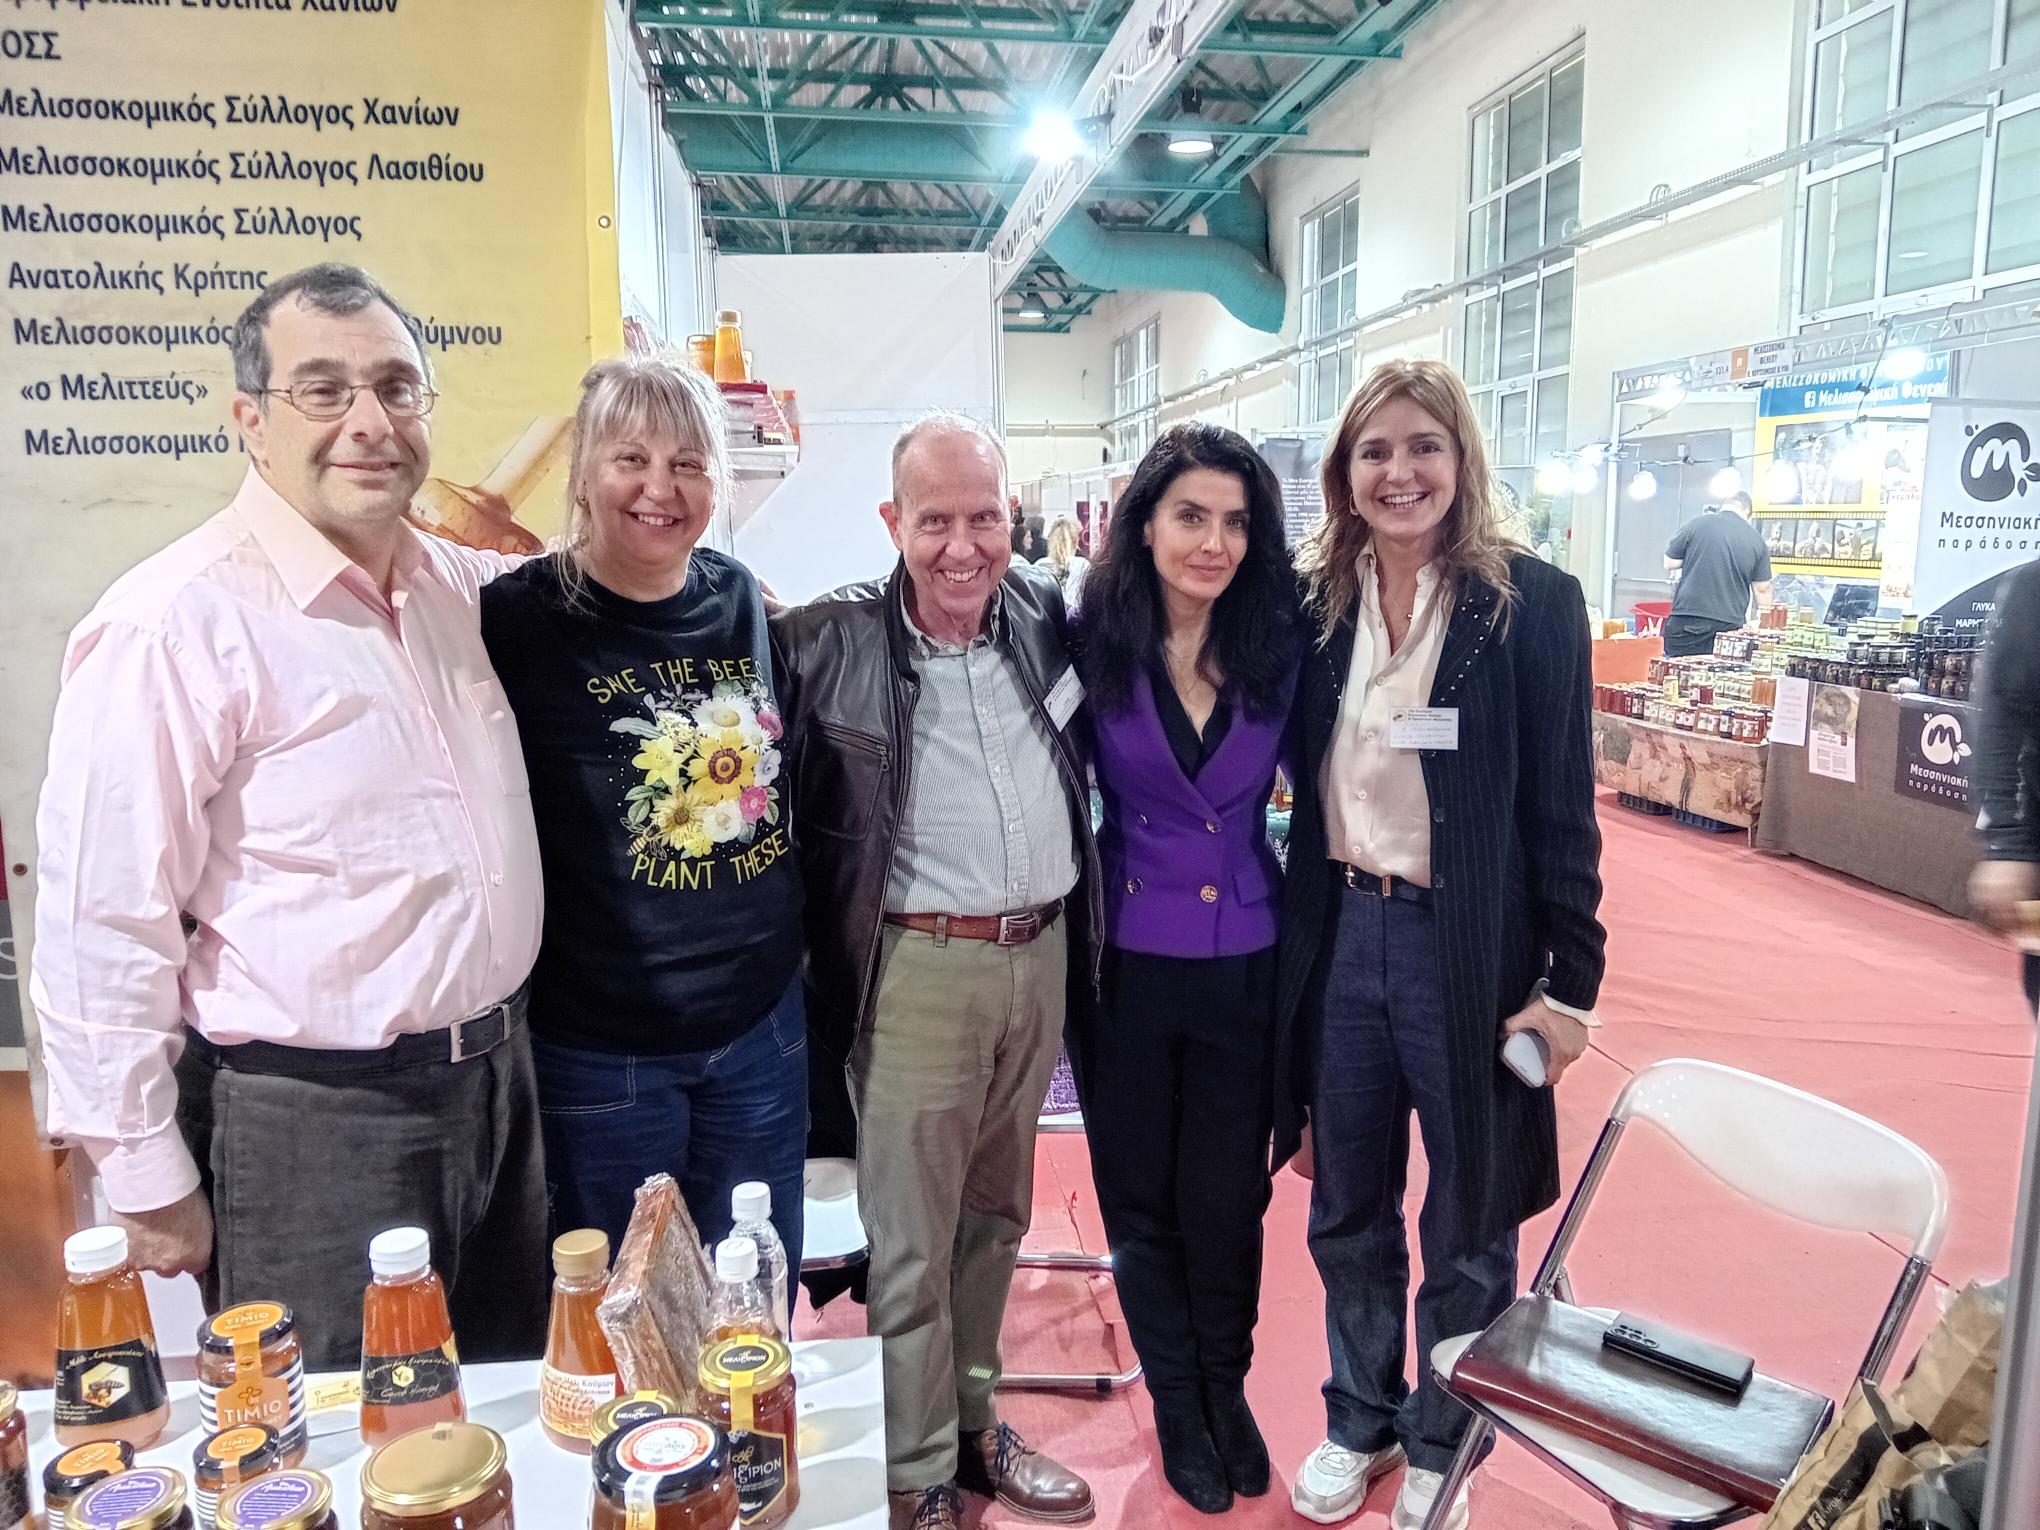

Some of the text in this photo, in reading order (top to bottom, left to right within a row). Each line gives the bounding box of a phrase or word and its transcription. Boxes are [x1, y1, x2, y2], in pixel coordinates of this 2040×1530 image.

[225, 94, 354, 131] Σύλλογος
[363, 97, 459, 126] Χανίων
[0, 146, 484, 187] Μελισσοκομικός Σύλλογος Λασιθίου
[1, 203, 362, 242] Μελισσοκομικός Σύλλογος
[9, 261, 268, 297] Ανατολικής Κρήτης
[14, 316, 233, 352] Μελισσοκομικός
[21, 371, 208, 405] «ο Μελιττεύς»
[25, 425, 229, 460] Μελισσοκομικό
[1971, 602, 1996, 612] ΓΛΥΚΑ
[649, 657, 699, 687] THE
[1908, 779, 1967, 801] παράδοση
[1909, 763, 1969, 788] Μεσσηνιακή
[631, 828, 789, 891] PLANT THESE
[223, 1399, 282, 1423] TIMIO
